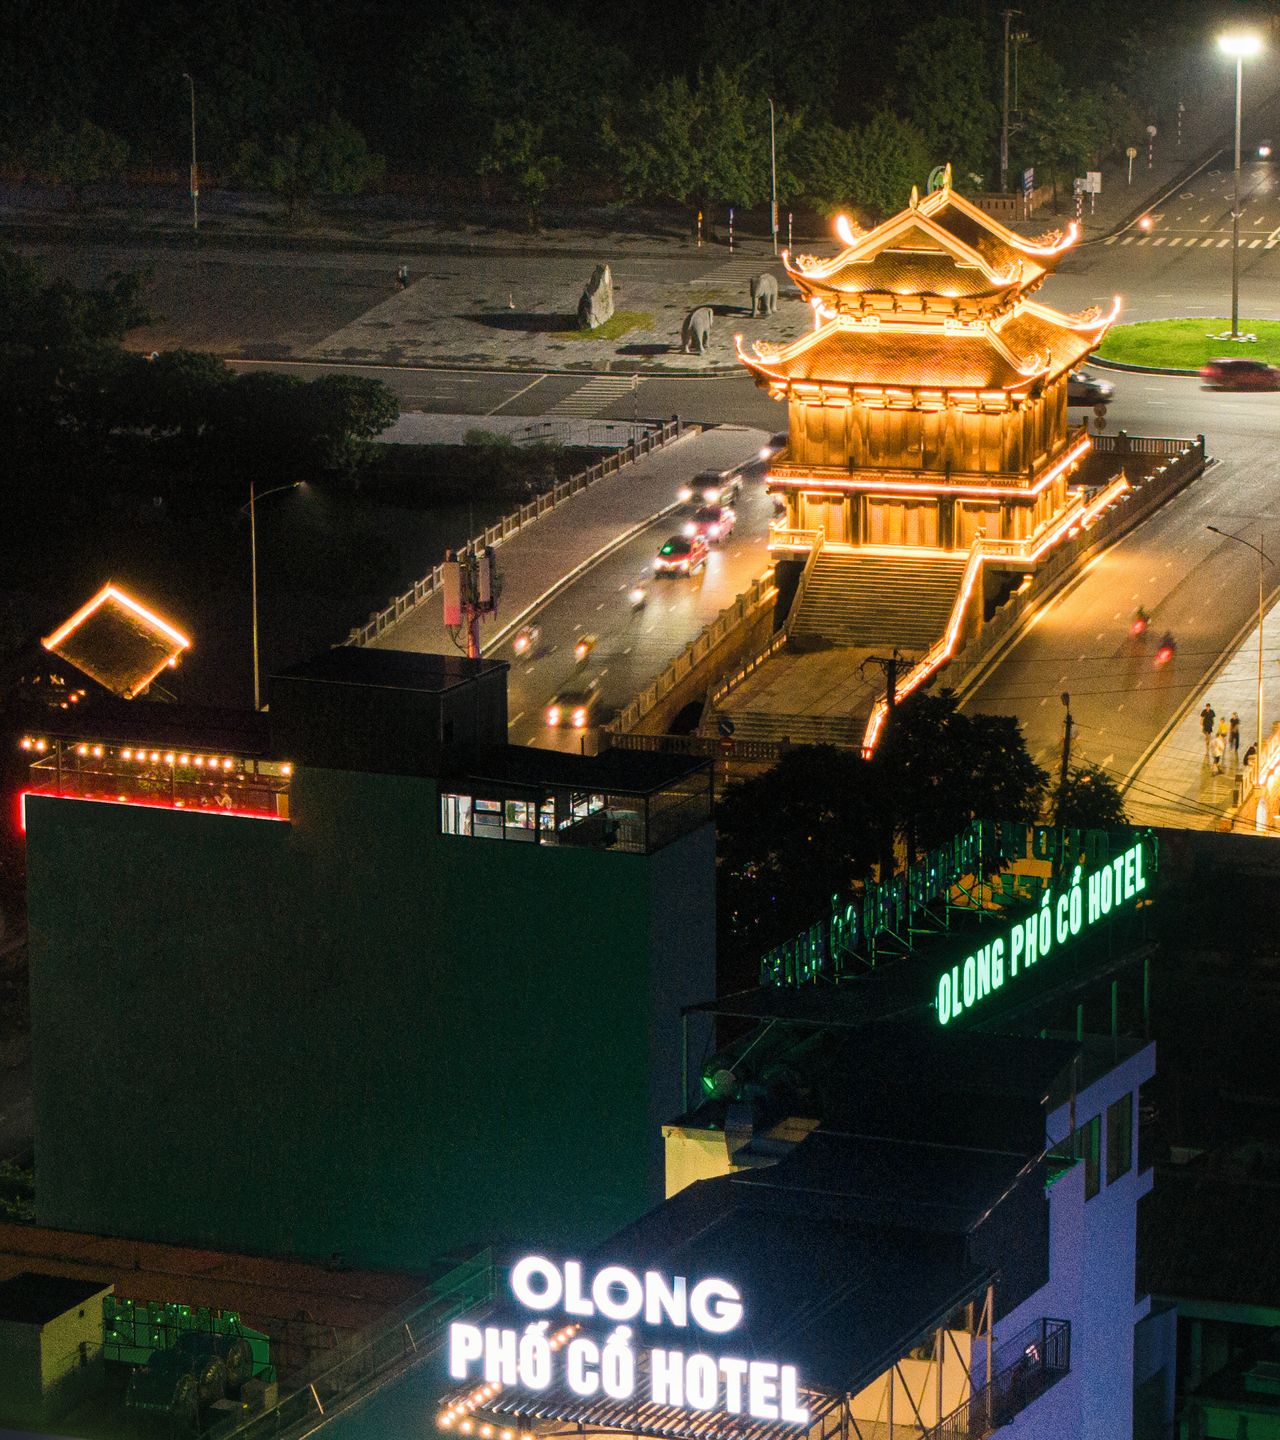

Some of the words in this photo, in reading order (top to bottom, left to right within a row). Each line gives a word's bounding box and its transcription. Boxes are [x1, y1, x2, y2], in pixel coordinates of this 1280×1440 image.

[937, 937, 1006, 1026] OLONG
[1010, 888, 1052, 978] PHỐ
[1056, 864, 1083, 945] CỔ
[1087, 842, 1147, 925] HOTEL
[510, 1254, 744, 1334] OLONG
[449, 1320, 552, 1390] PHỐ
[650, 1347, 811, 1426] HOTEL
